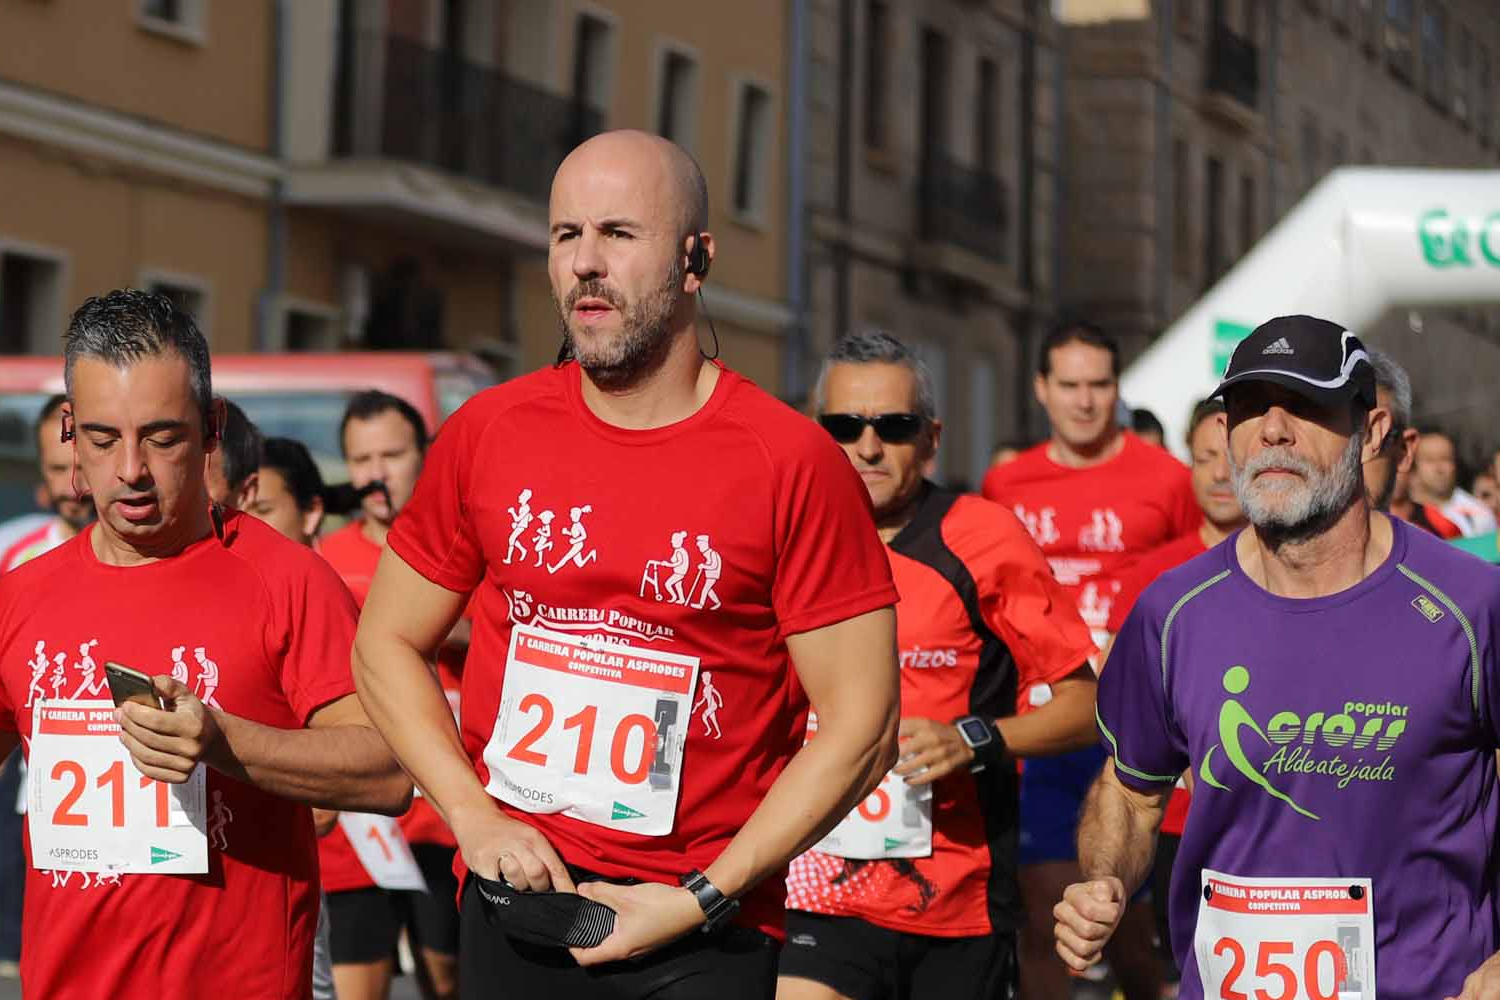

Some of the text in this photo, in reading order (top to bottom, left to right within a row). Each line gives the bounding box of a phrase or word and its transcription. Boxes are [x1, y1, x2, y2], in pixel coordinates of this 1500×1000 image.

[607, 611, 674, 636] POPULAR
[518, 635, 525, 647] V
[527, 639, 569, 657] CARRERA
[573, 649, 624, 668] POPULAR
[627, 660, 685, 678] ASPRODES
[568, 661, 623, 679] COMPETITIVA
[42, 711, 47, 720] V
[48, 711, 86, 720] CARRERA
[1344, 701, 1409, 717] popular
[505, 693, 658, 785] 210
[1263, 743, 1394, 789] Aldeatejada
[51, 760, 169, 828] 211
[49, 848, 98, 860] ASPRODES
[1215, 883, 1246, 898] CARRERA
[1250, 889, 1300, 900] POPULAR
[1303, 889, 1350, 900] ASPROD
[1248, 902, 1300, 911] COMPETITIVA
